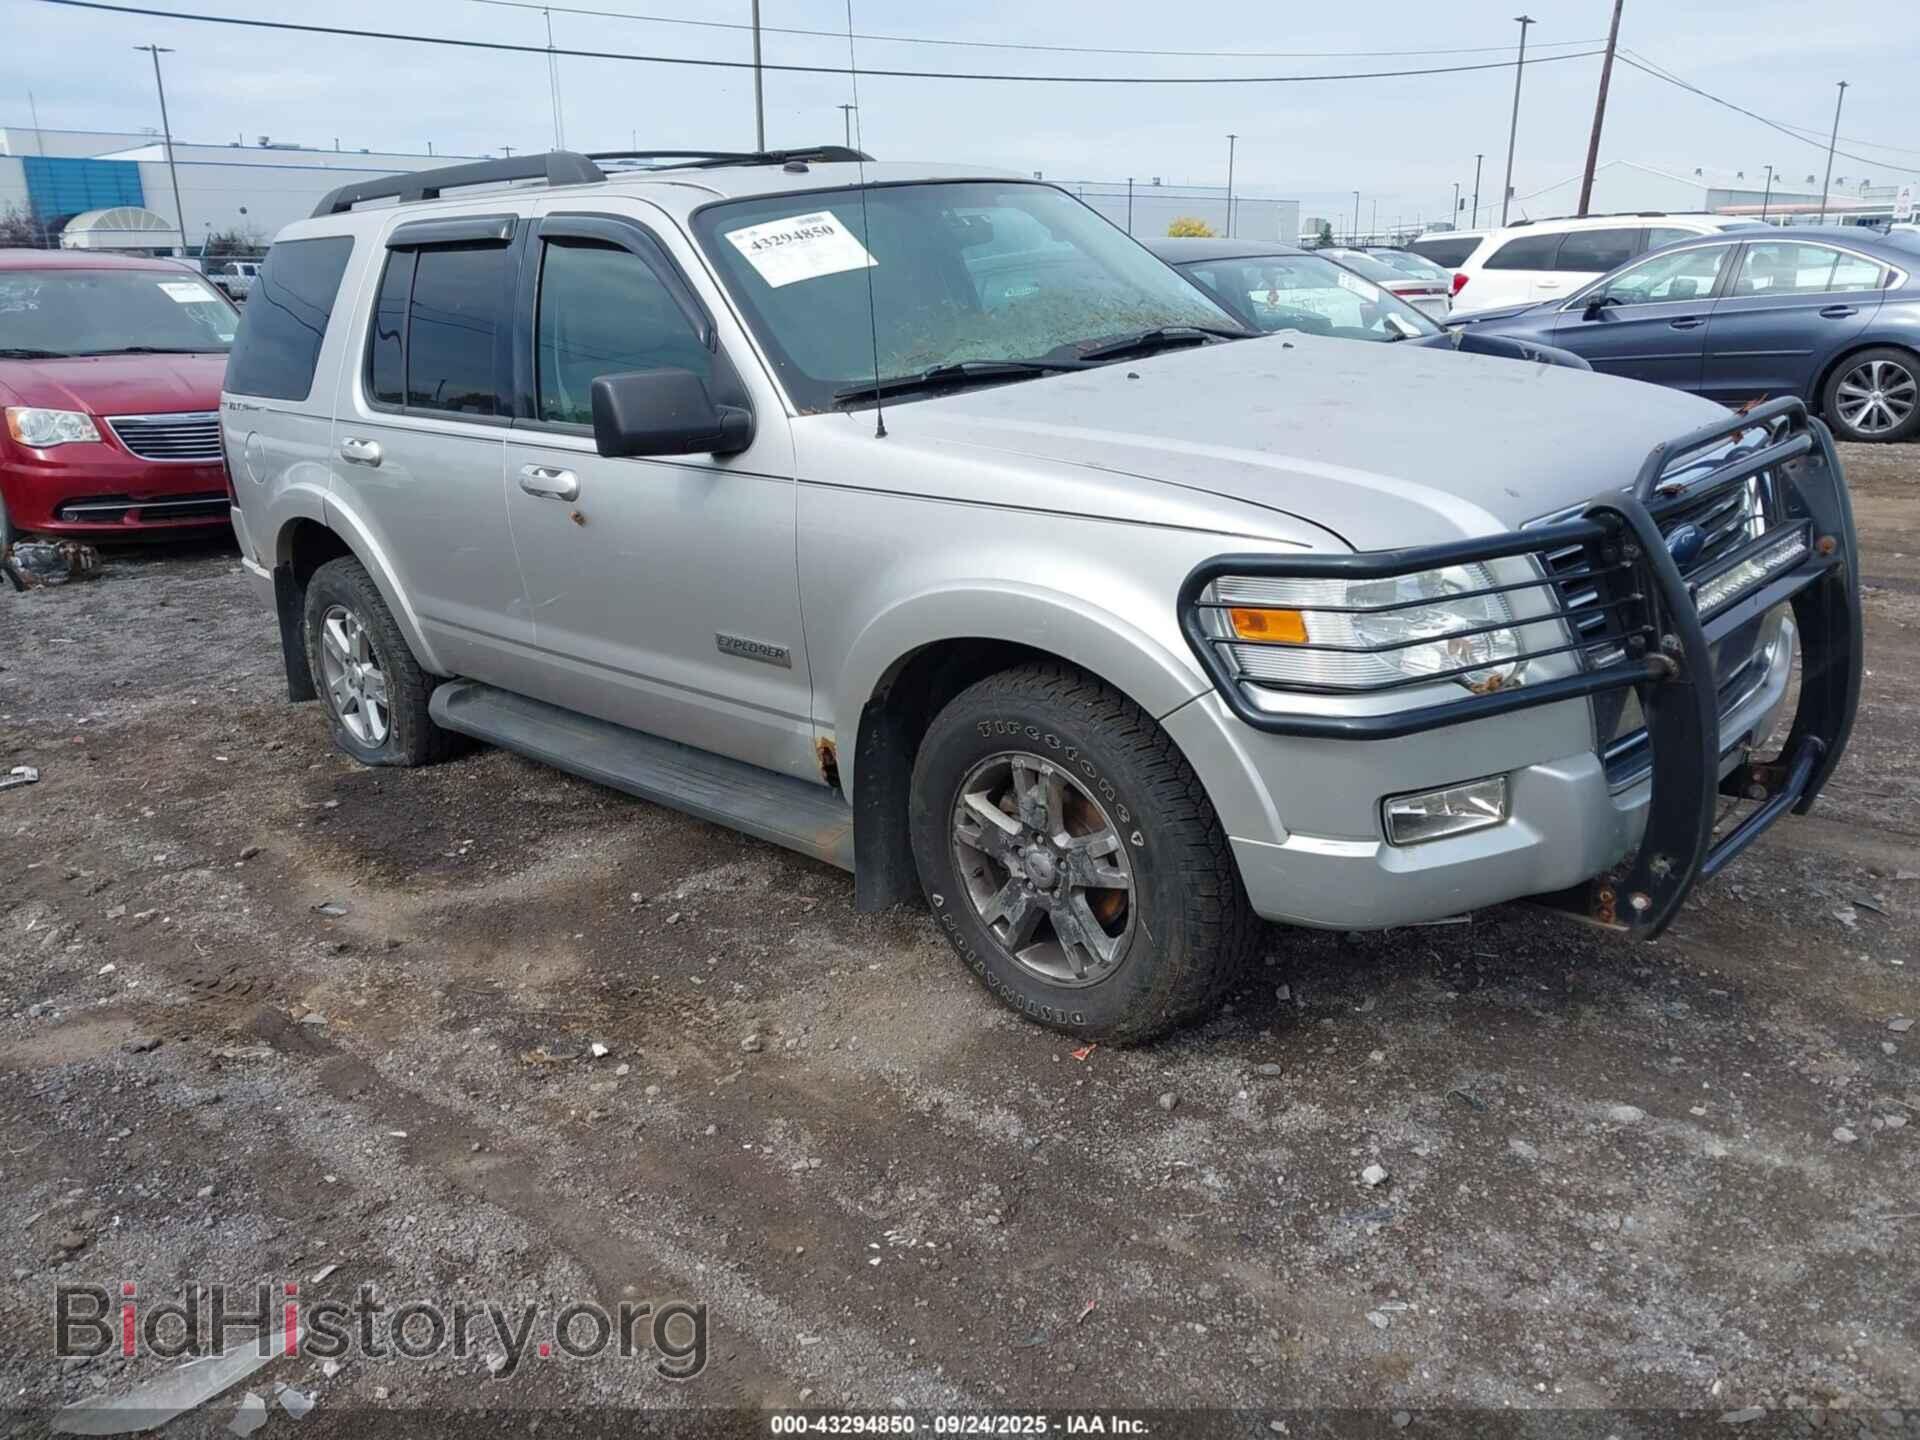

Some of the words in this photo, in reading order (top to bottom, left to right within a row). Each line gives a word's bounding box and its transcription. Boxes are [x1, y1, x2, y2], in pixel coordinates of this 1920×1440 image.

[751, 224, 835, 251] 43294850
[718, 634, 787, 659] EXPLORER
[941, 913, 1087, 1026] DESTINATION
